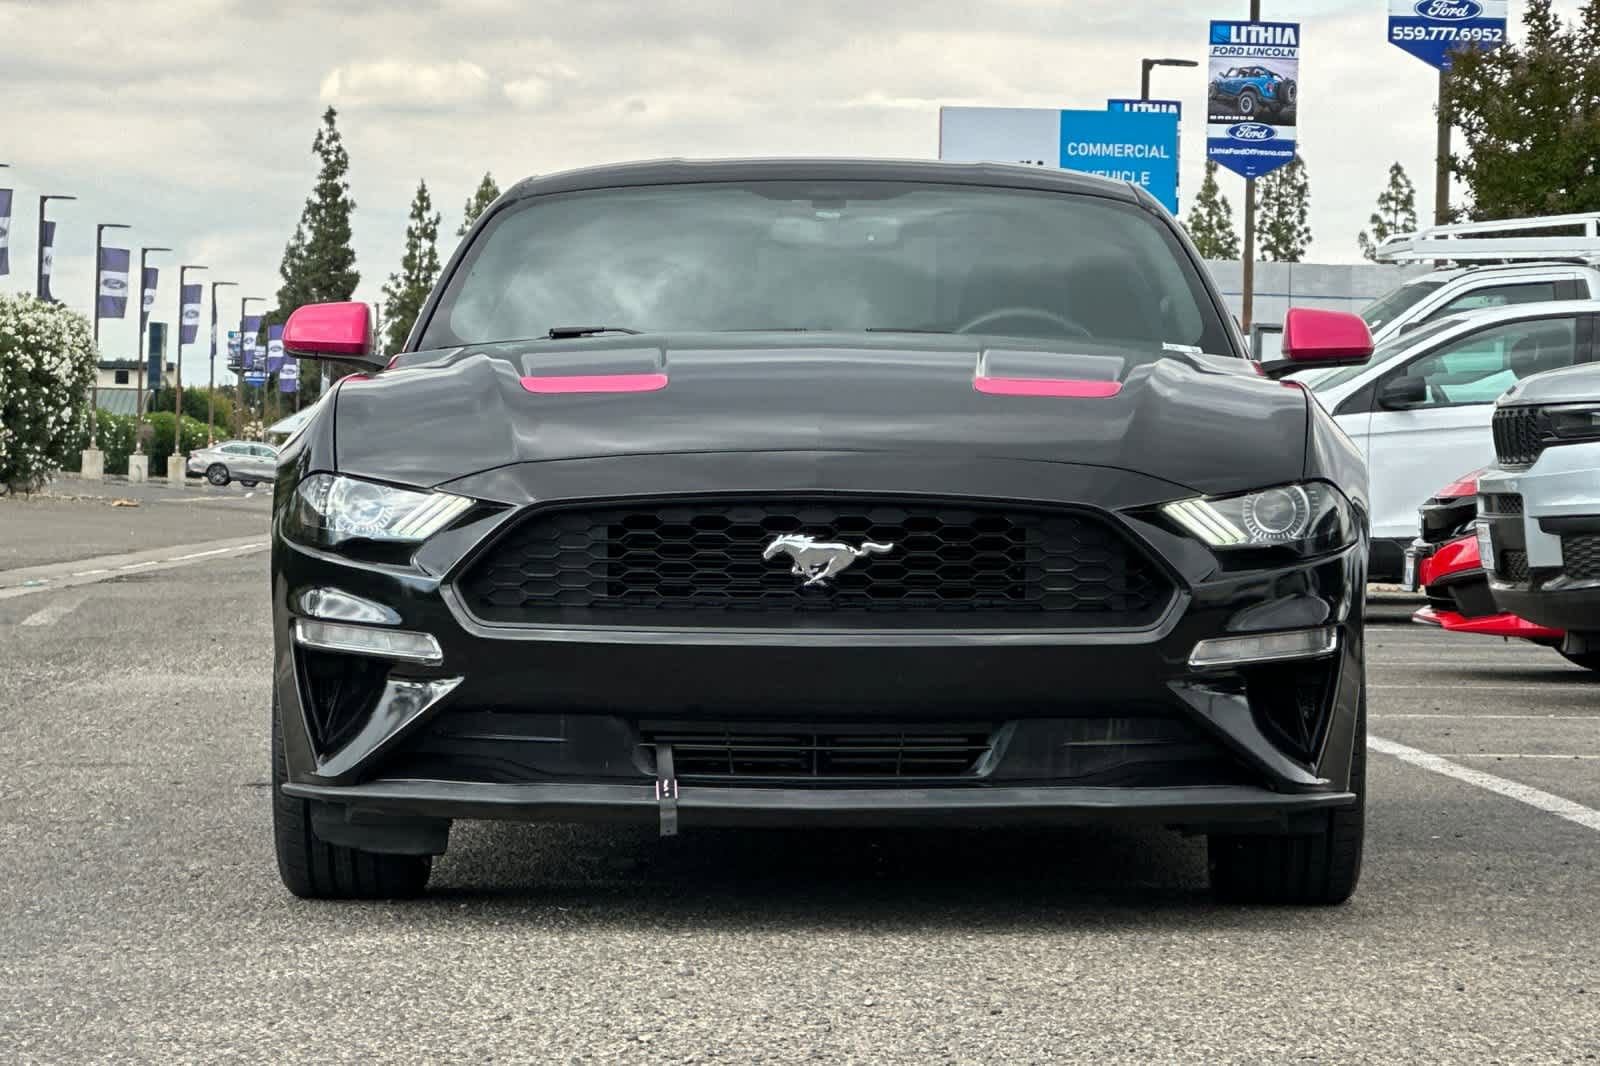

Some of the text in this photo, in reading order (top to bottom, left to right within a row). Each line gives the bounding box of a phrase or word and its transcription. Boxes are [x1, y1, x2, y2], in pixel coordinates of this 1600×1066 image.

[1428, 0, 1469, 16] Ford
[1230, 25, 1296, 45] LITHIA
[1392, 26, 1502, 42] 559.777.6952
[1212, 46, 1296, 57] FORD LINCOLN
[1236, 125, 1267, 138] Ford
[1067, 142, 1170, 159] COMMERCIAL
